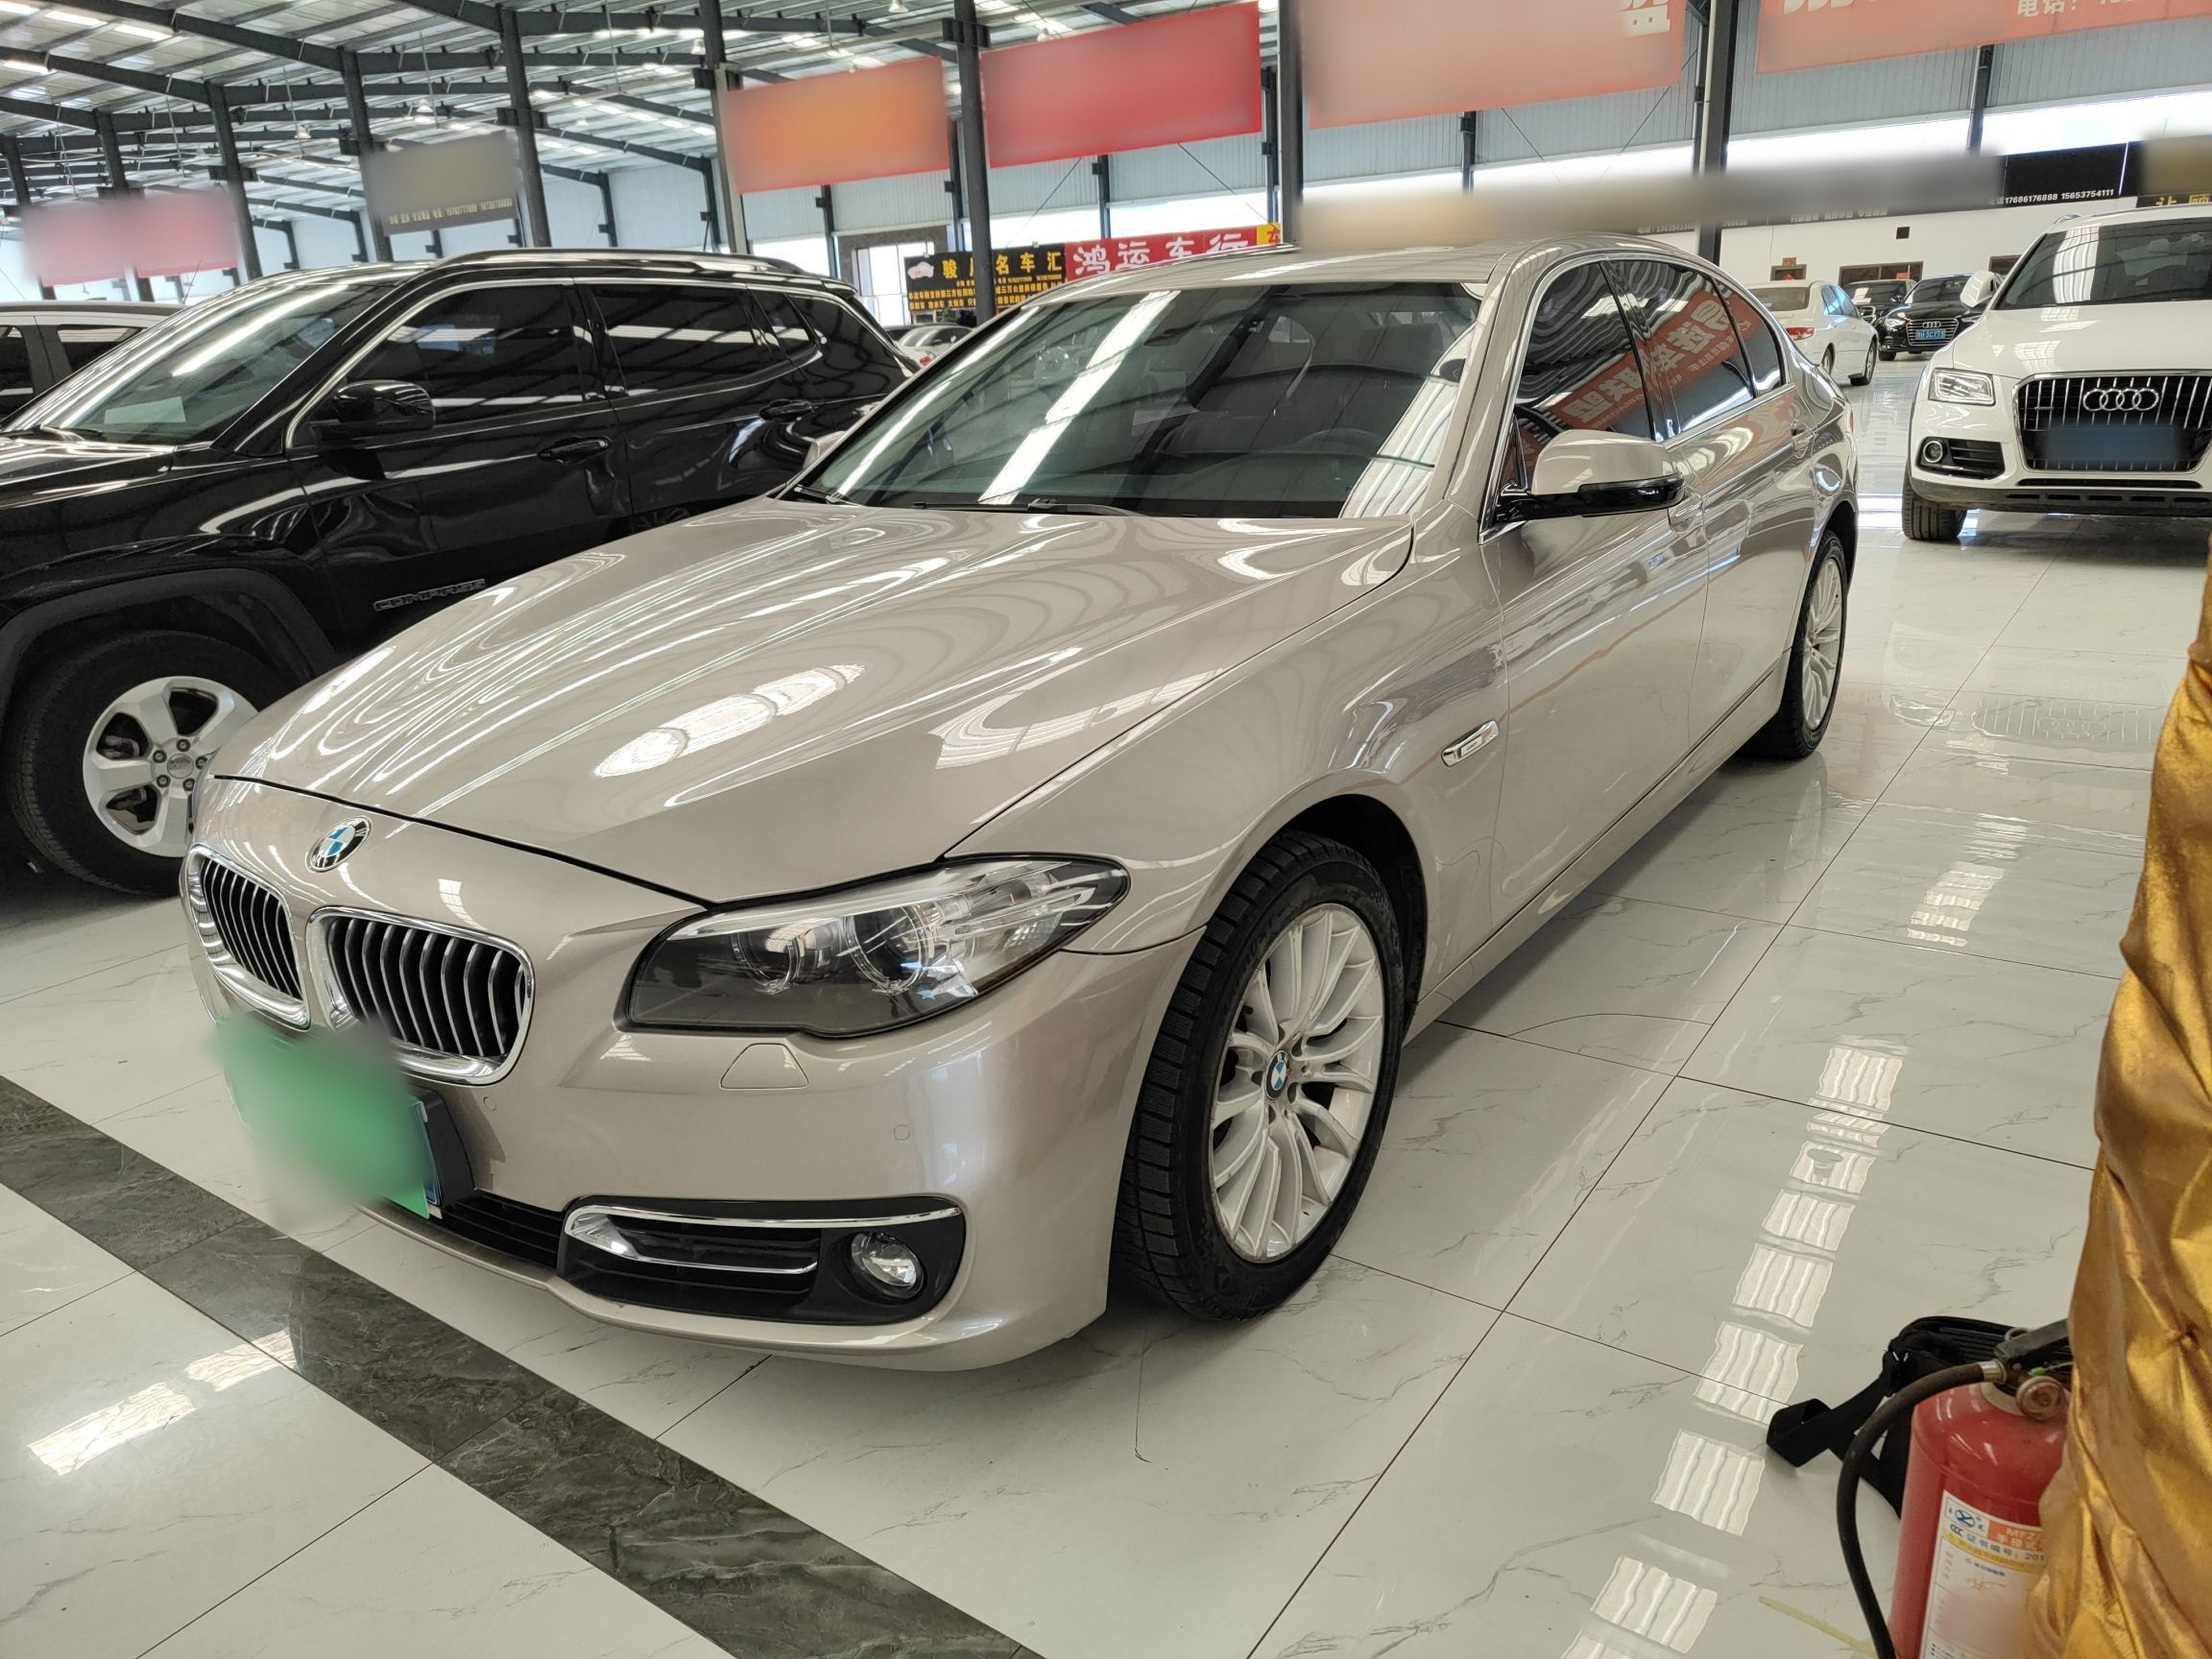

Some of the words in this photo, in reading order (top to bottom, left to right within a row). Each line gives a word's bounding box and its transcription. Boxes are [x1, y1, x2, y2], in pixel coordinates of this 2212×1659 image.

[2061, 189, 2114, 199] 15653754111
[942, 251, 1062, 279] 骏名车汇
[1073, 232, 1248, 275] 鸿运车行
